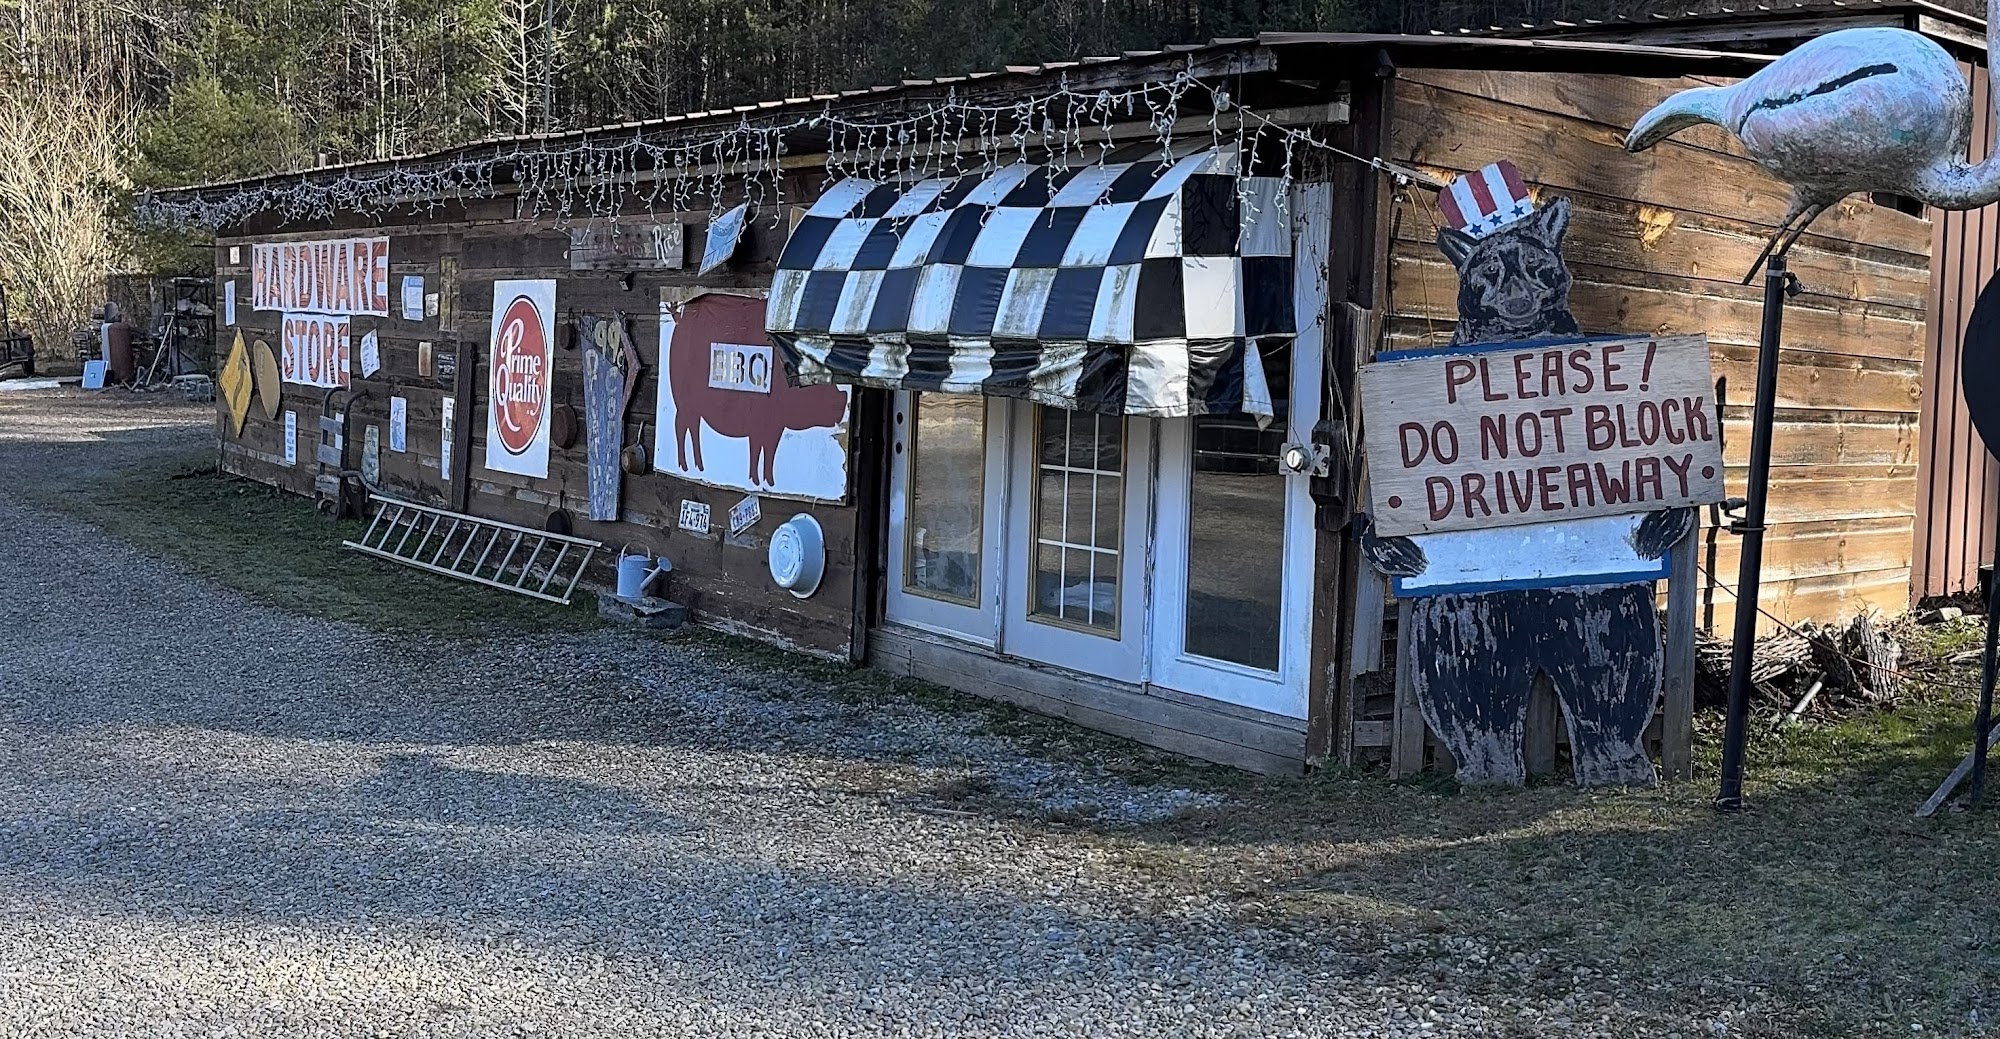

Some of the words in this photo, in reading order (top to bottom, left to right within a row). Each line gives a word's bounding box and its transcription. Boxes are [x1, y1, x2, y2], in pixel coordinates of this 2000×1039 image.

[254, 242, 387, 311] HARDWARE
[652, 225, 681, 264] Rice
[284, 318, 348, 386] STORE
[500, 318, 541, 373] Prime
[711, 349, 769, 386] BBQ
[1445, 341, 1657, 404] PLEASE!
[496, 364, 544, 432] Quality
[1399, 421, 1459, 469] DO
[1480, 407, 1573, 461] NOT
[1585, 397, 1713, 452] BLOCK
[1424, 453, 1694, 522] DRIVEAWAY
